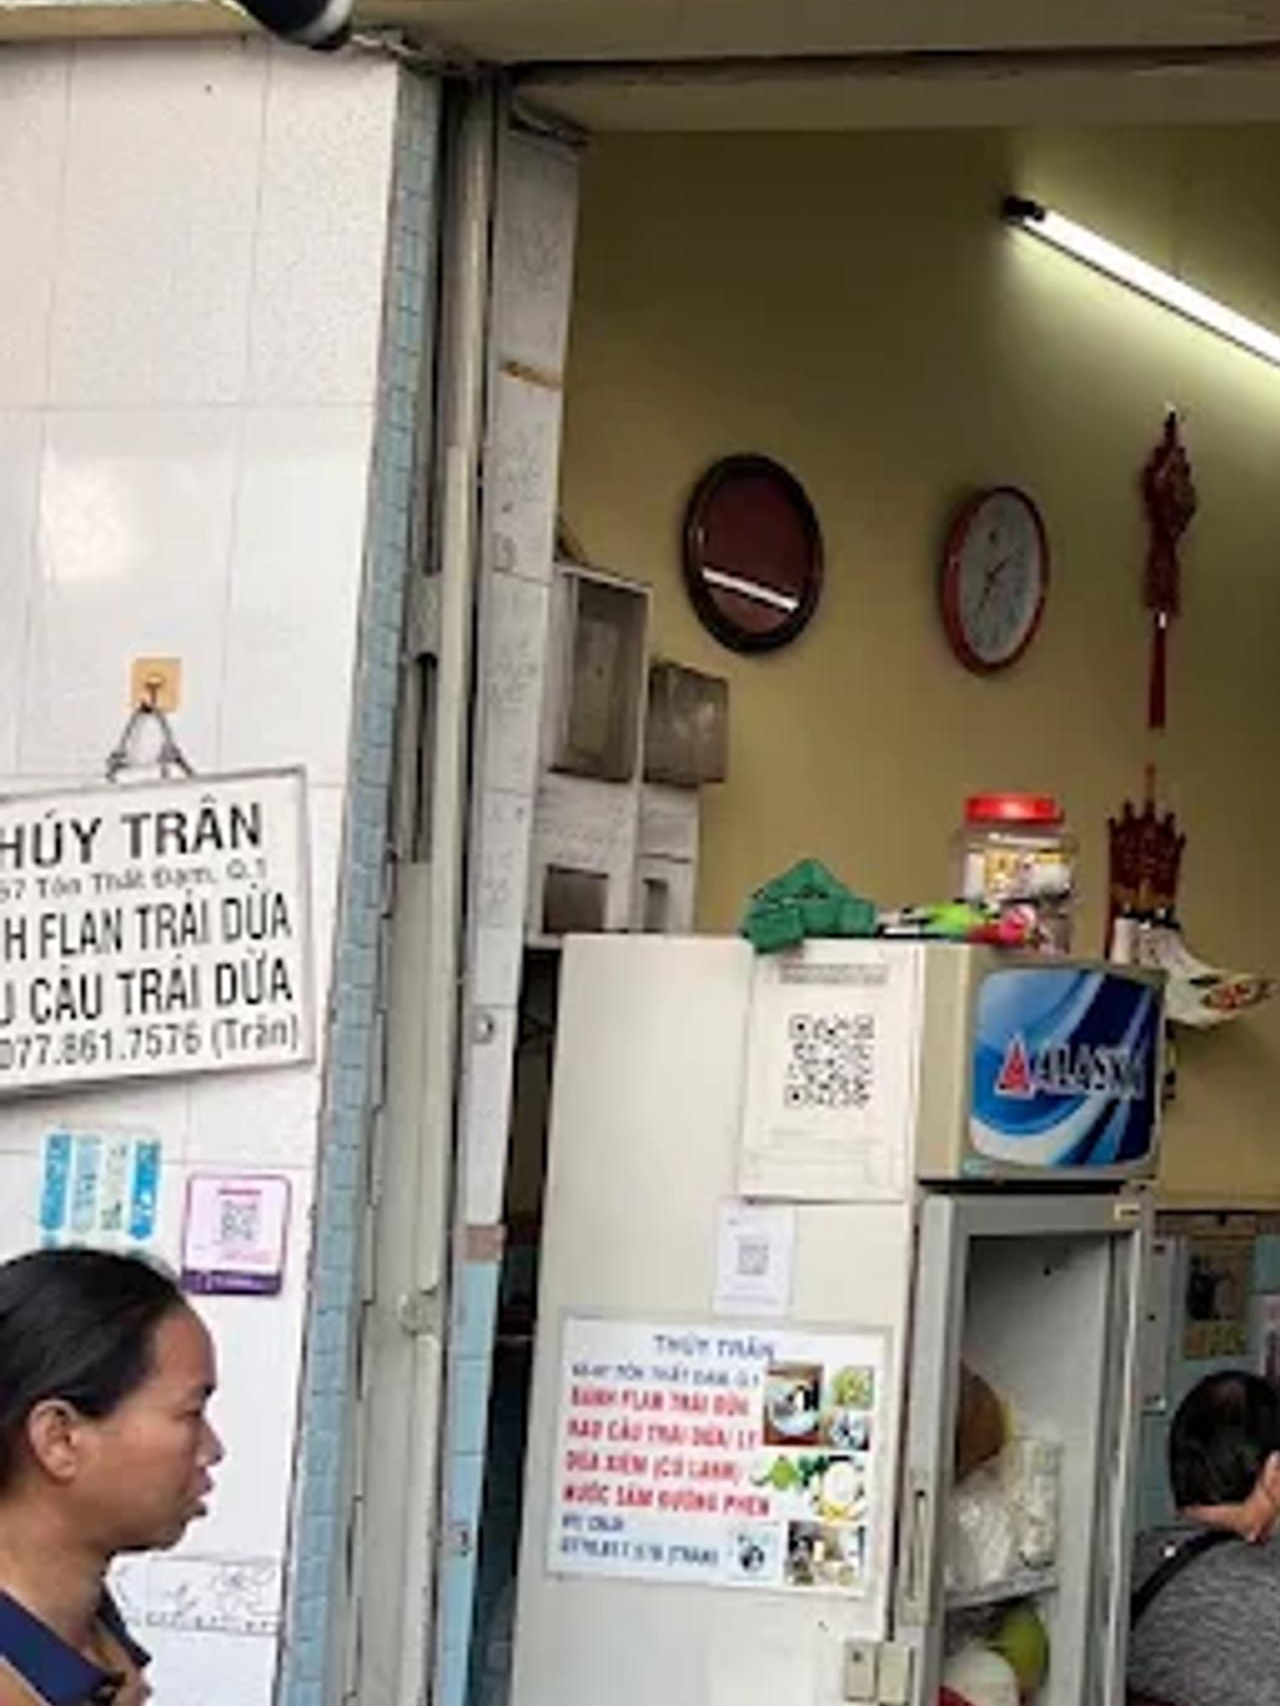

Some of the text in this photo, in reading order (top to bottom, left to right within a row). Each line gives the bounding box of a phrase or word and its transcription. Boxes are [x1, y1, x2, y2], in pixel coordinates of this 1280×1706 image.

[119, 791, 263, 860] TRÂN
[39, 903, 123, 960] FLAN
[134, 888, 212, 951] TRÁI
[220, 881, 293, 943] DỪA
[115, 951, 200, 1015] TRÁI
[214, 945, 293, 1007] DỪA
